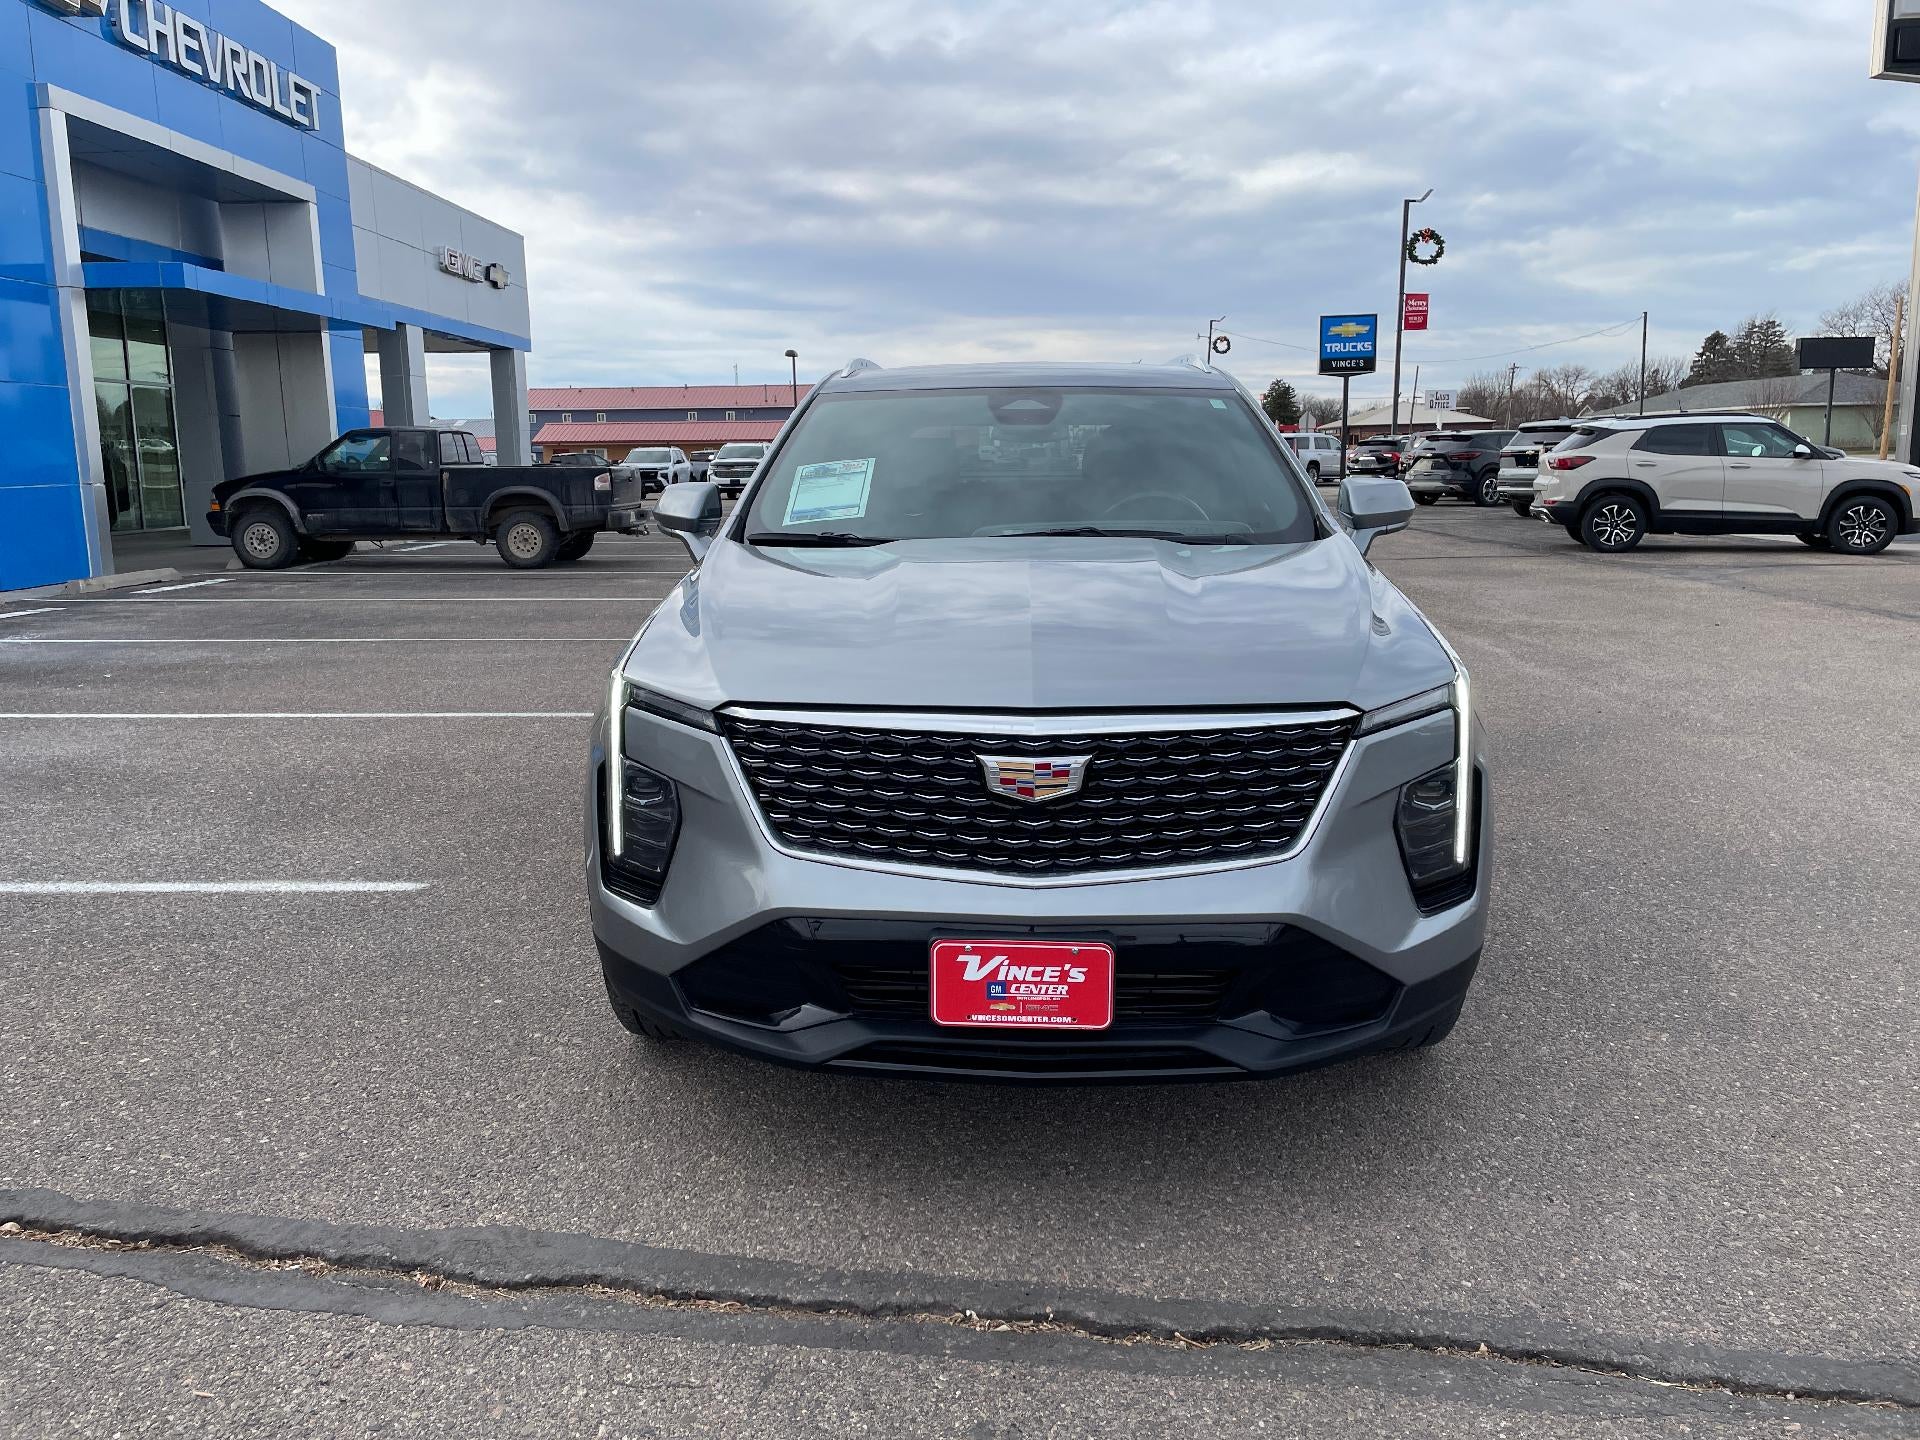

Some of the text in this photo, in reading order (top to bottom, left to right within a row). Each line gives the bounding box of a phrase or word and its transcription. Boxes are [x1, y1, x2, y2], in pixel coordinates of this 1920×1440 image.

[118, 0, 322, 131] CHEVROLET
[444, 247, 484, 282] GMC
[1325, 342, 1372, 352] TRUCKS
[1331, 360, 1364, 368] VINCE'S
[990, 985, 1002, 993] GM
[1009, 983, 1069, 995] CENTER
